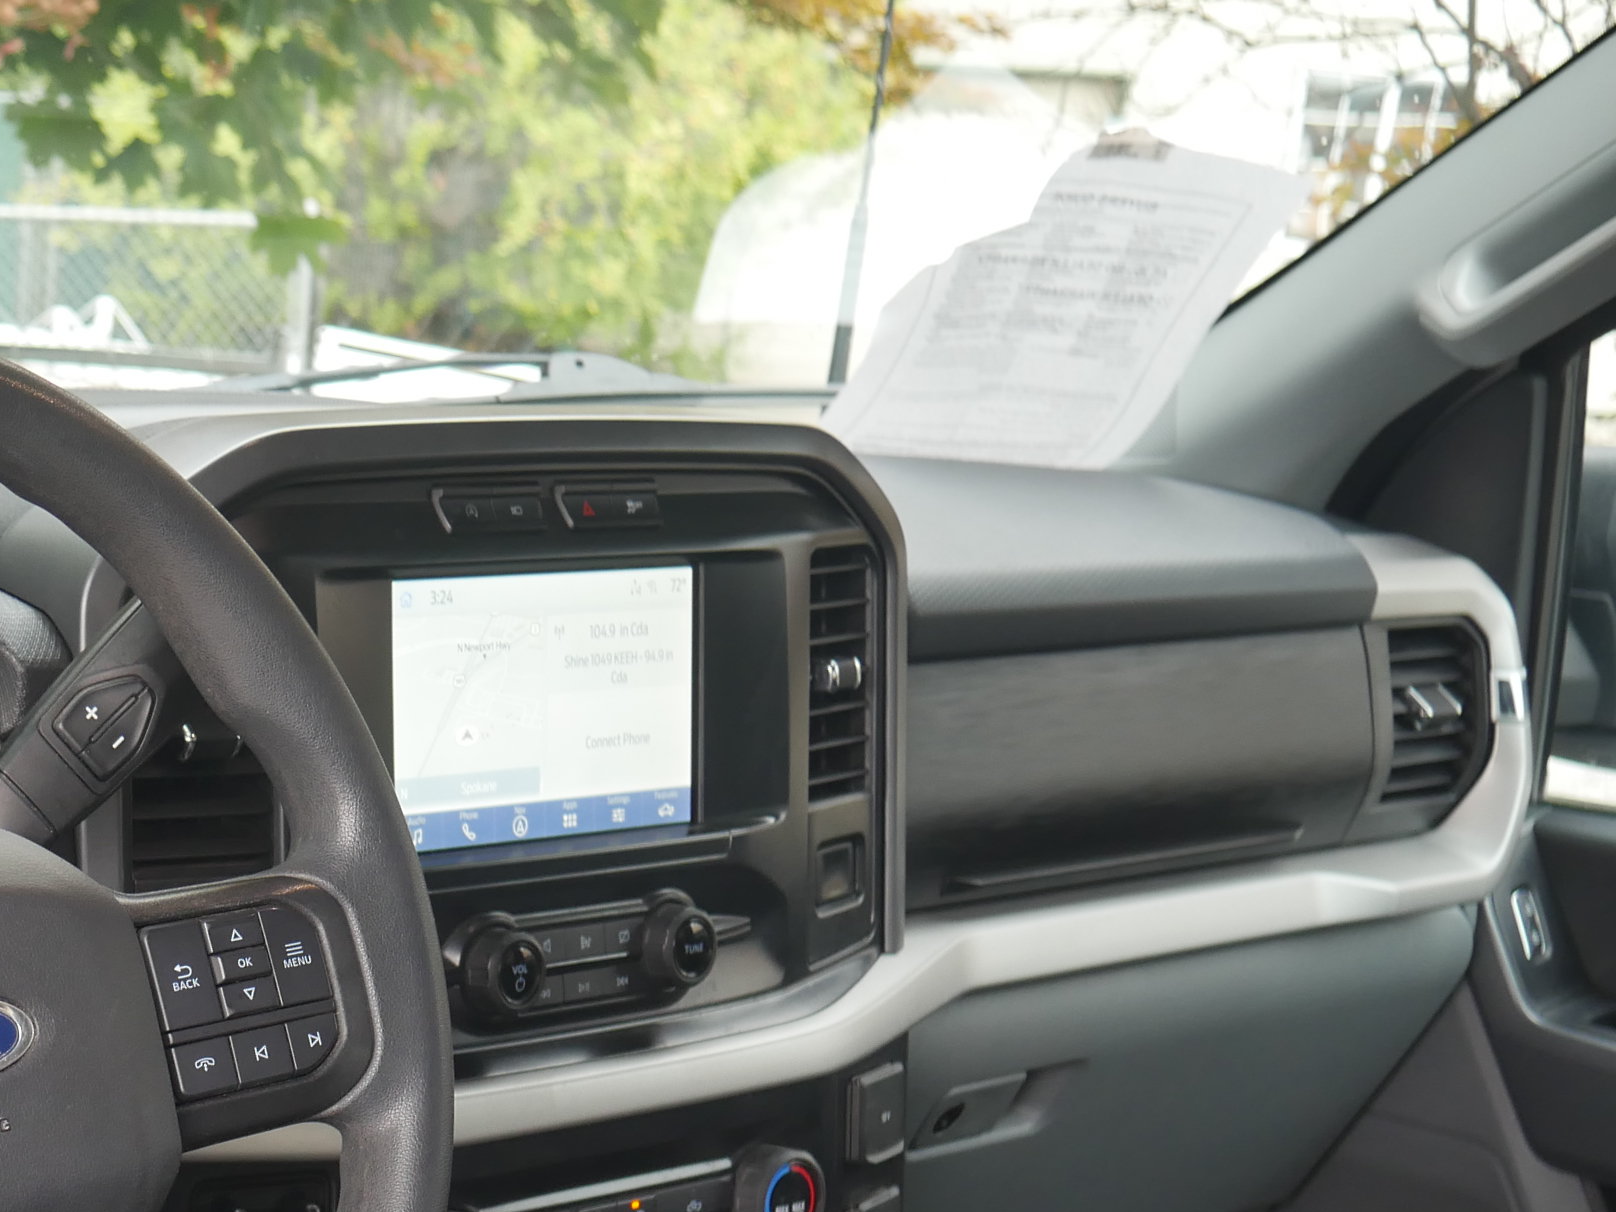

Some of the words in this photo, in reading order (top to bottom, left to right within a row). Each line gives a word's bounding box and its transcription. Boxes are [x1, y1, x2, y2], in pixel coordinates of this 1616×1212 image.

[430, 590, 454, 606] 3:24
[589, 624, 616, 640] 104.9
[564, 654, 590, 669] Shine
[585, 734, 622, 750] Connect
[623, 732, 651, 747] Phone
[237, 957, 254, 969] OK
[283, 955, 312, 969] MENU
[511, 964, 528, 976] VOL
[172, 978, 201, 993] BACK
